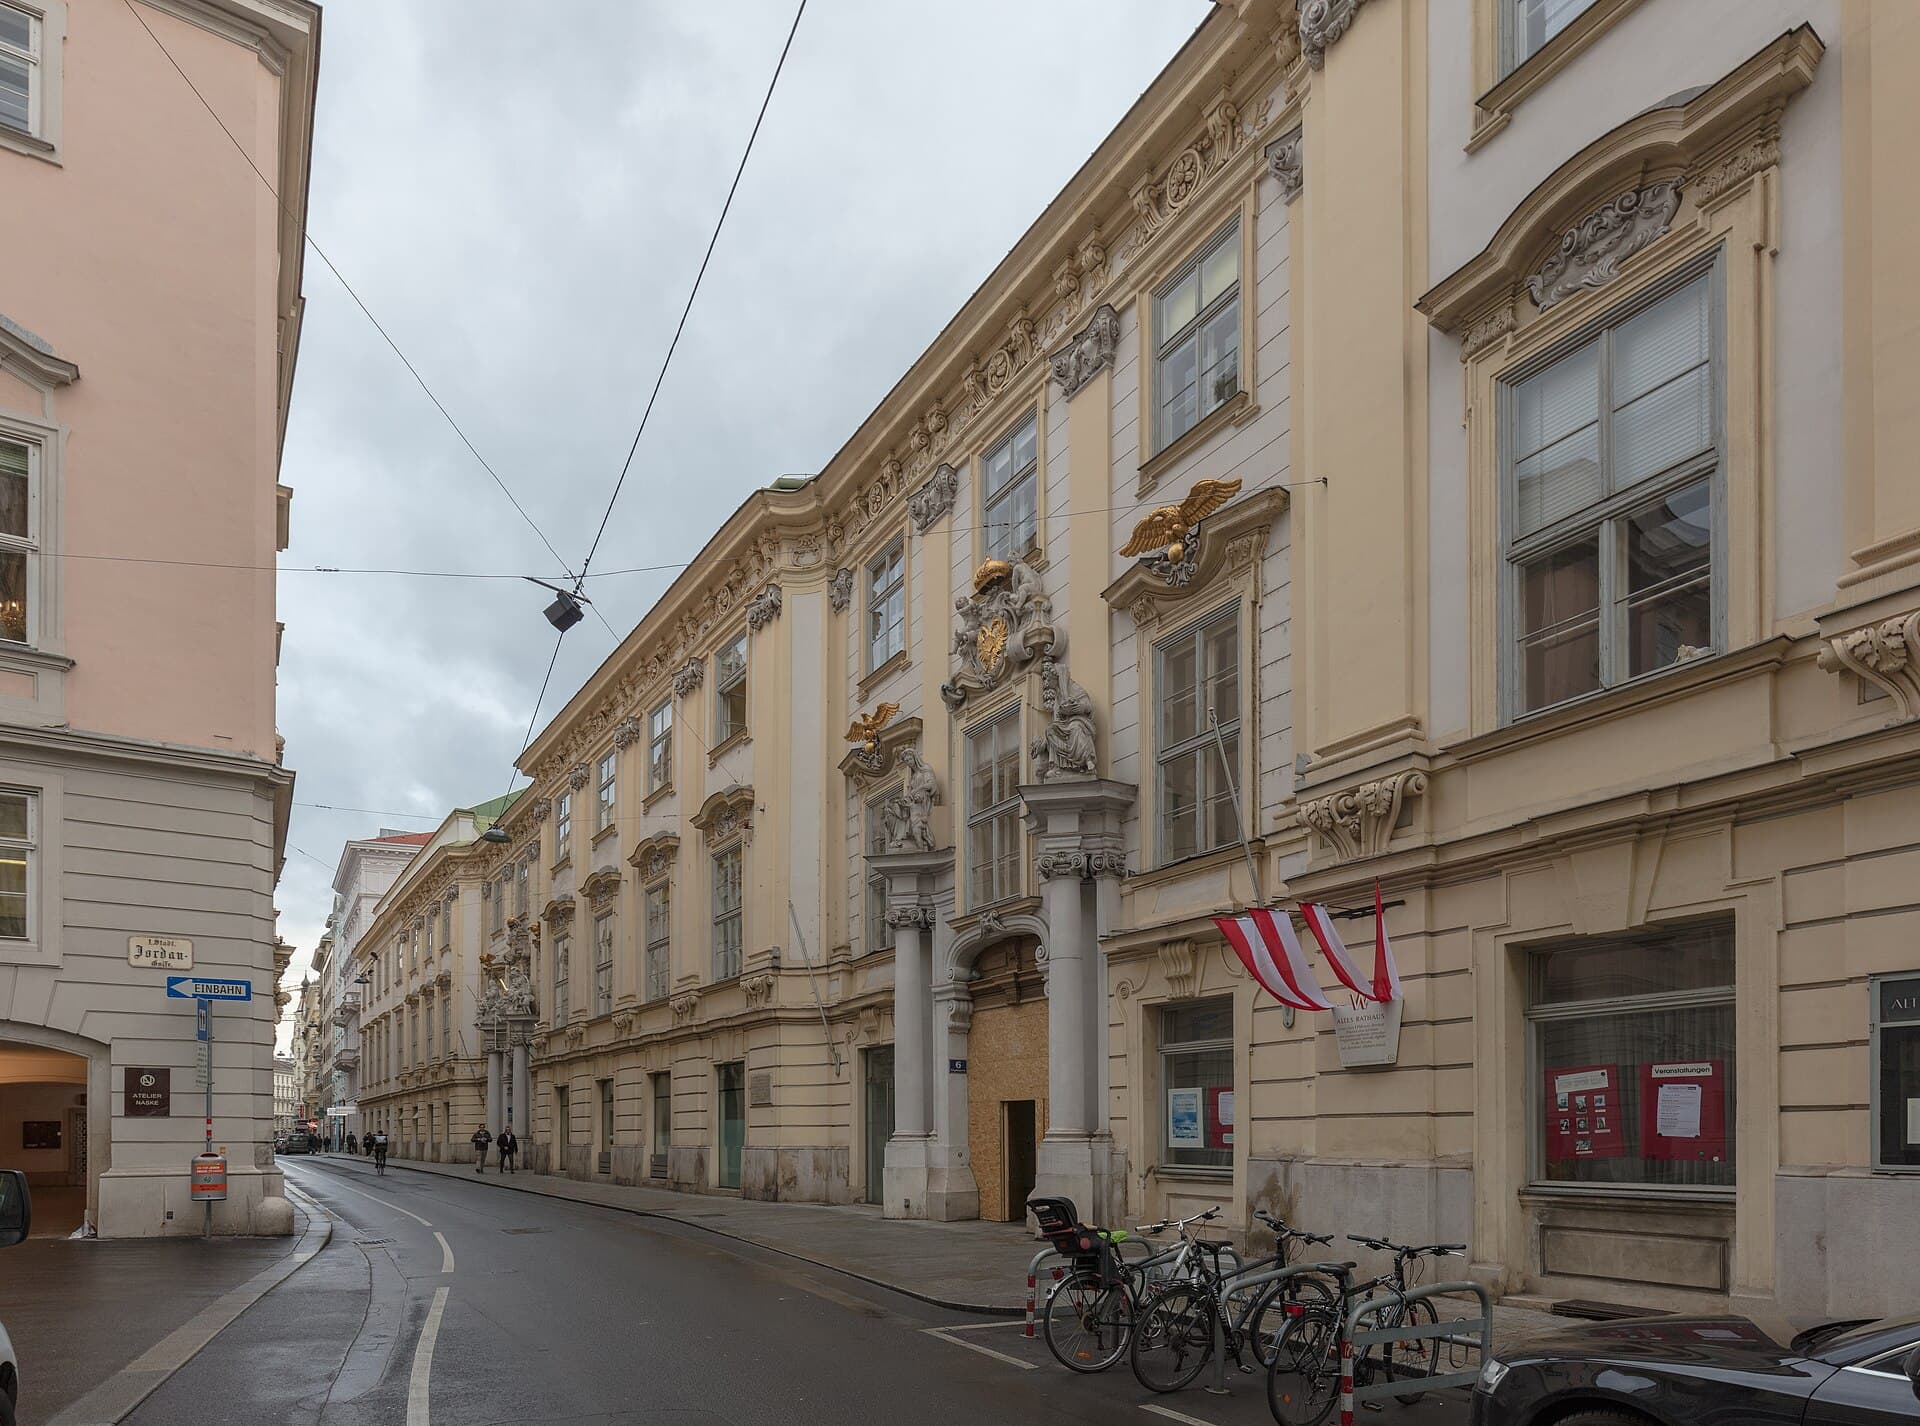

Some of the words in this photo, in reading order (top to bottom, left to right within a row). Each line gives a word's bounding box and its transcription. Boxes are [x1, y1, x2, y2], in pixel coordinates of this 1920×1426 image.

[194, 983, 242, 995] EINBAHN
[1356, 1013, 1385, 1022] RATHAUS
[955, 1060, 962, 1069] 6
[1654, 1066, 1710, 1074] Veranstaltungen
